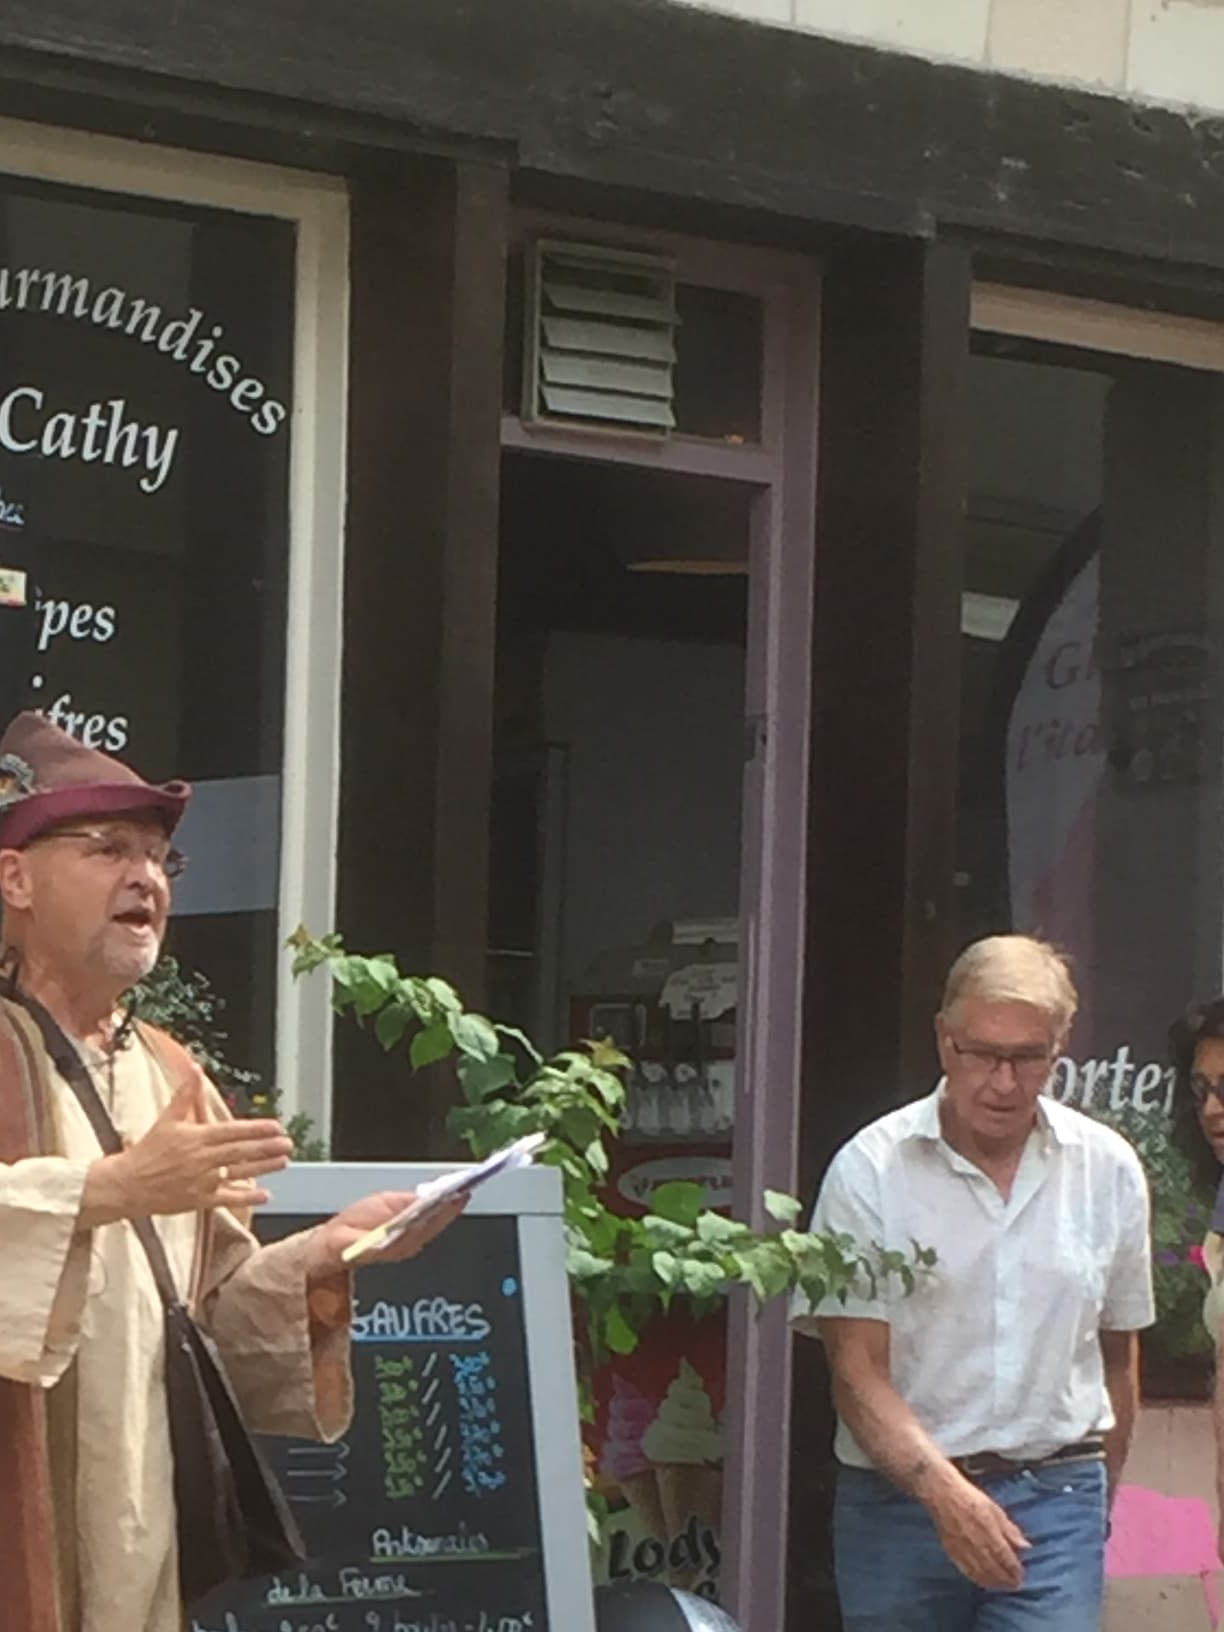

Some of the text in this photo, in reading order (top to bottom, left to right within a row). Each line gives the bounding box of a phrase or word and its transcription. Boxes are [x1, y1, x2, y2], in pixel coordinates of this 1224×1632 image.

[36, 596, 116, 651] pes
[40, 694, 129, 752] fres
[1043, 1045, 1177, 1115] orte
